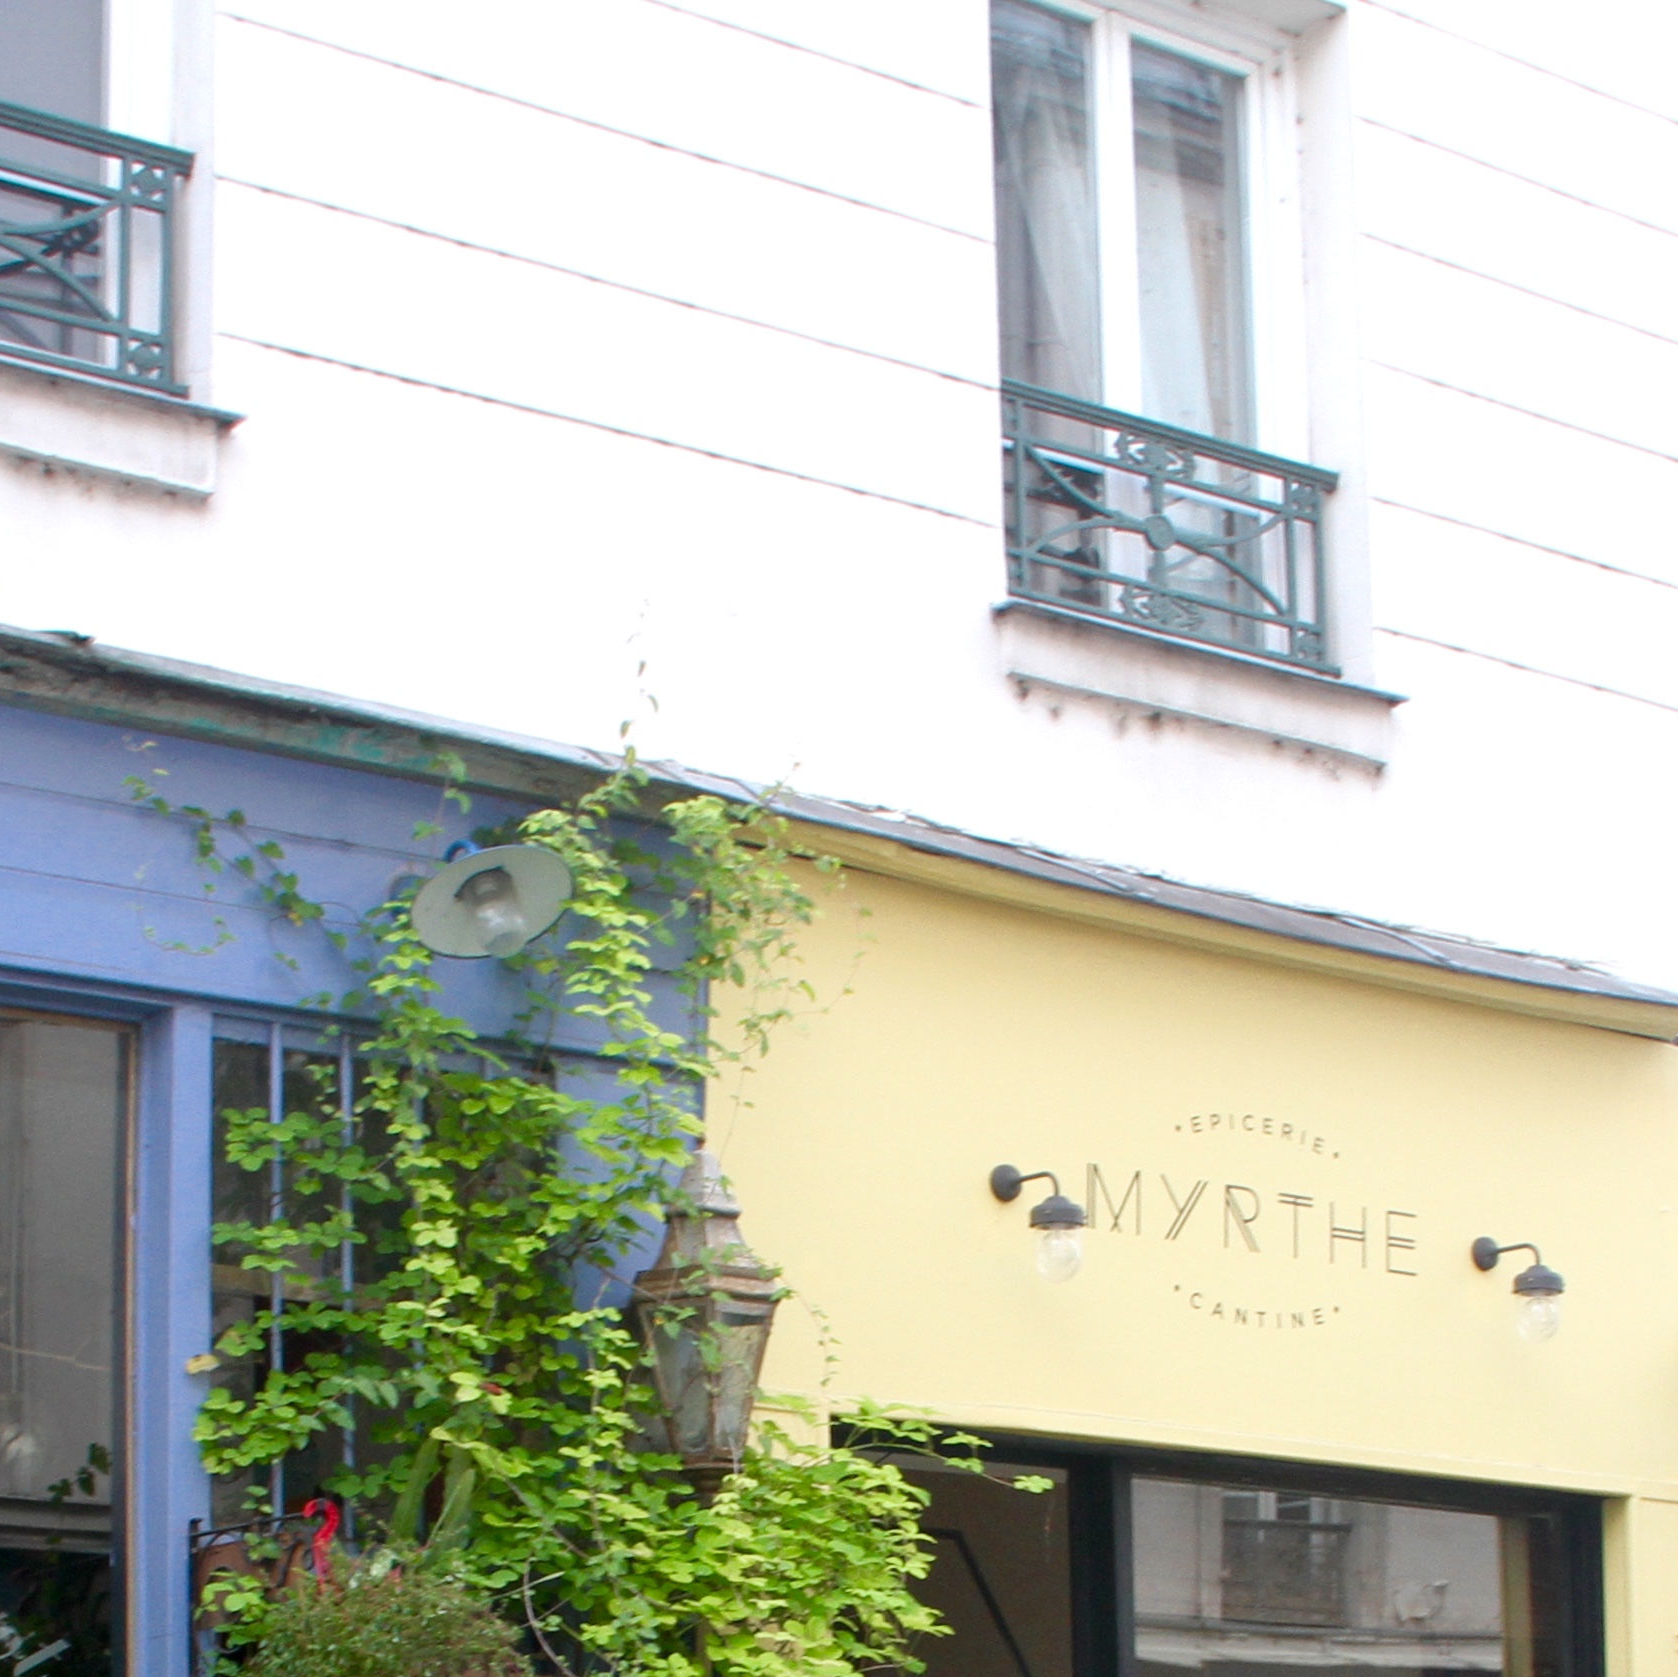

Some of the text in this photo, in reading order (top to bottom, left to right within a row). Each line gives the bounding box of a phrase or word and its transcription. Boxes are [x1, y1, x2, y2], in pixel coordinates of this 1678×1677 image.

[1189, 1111, 1325, 1155] EPICERIE
[1084, 1161, 1419, 1277] MYRTHE
[1188, 1291, 1326, 1329] CANTINE
